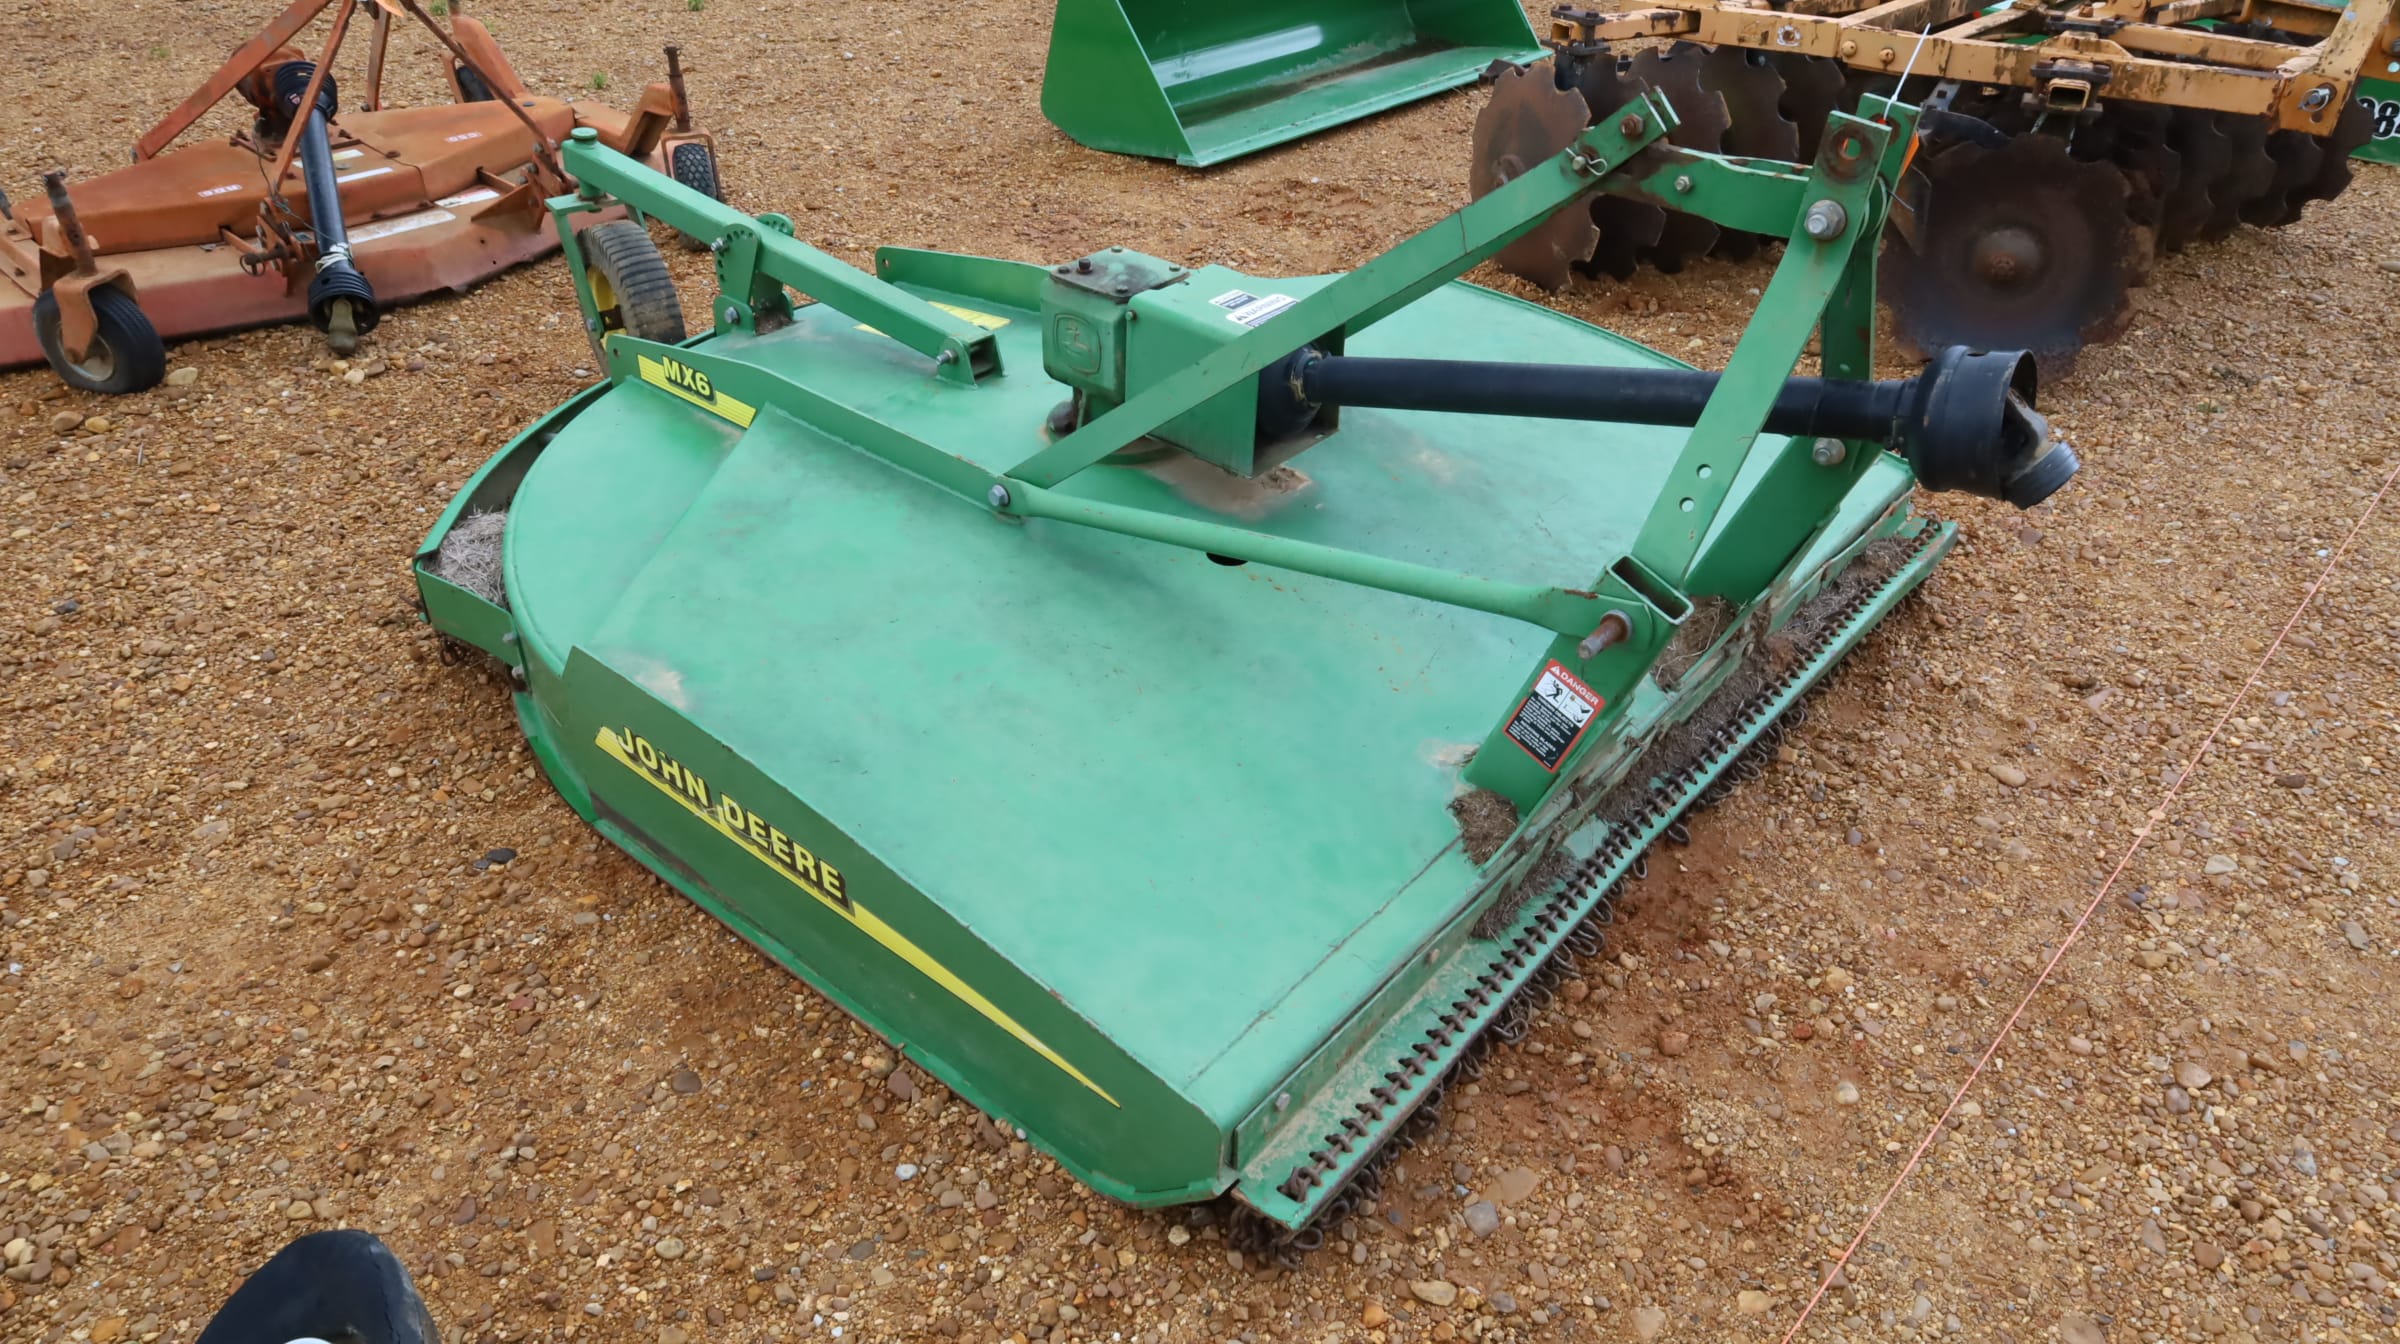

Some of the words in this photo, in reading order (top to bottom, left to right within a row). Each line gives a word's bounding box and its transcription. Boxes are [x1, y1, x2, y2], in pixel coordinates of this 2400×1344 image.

[662, 355, 711, 396] MX6
[1559, 670, 1599, 705] DANGER
[617, 726, 708, 807] JOHN
[717, 792, 842, 898] DEERE
